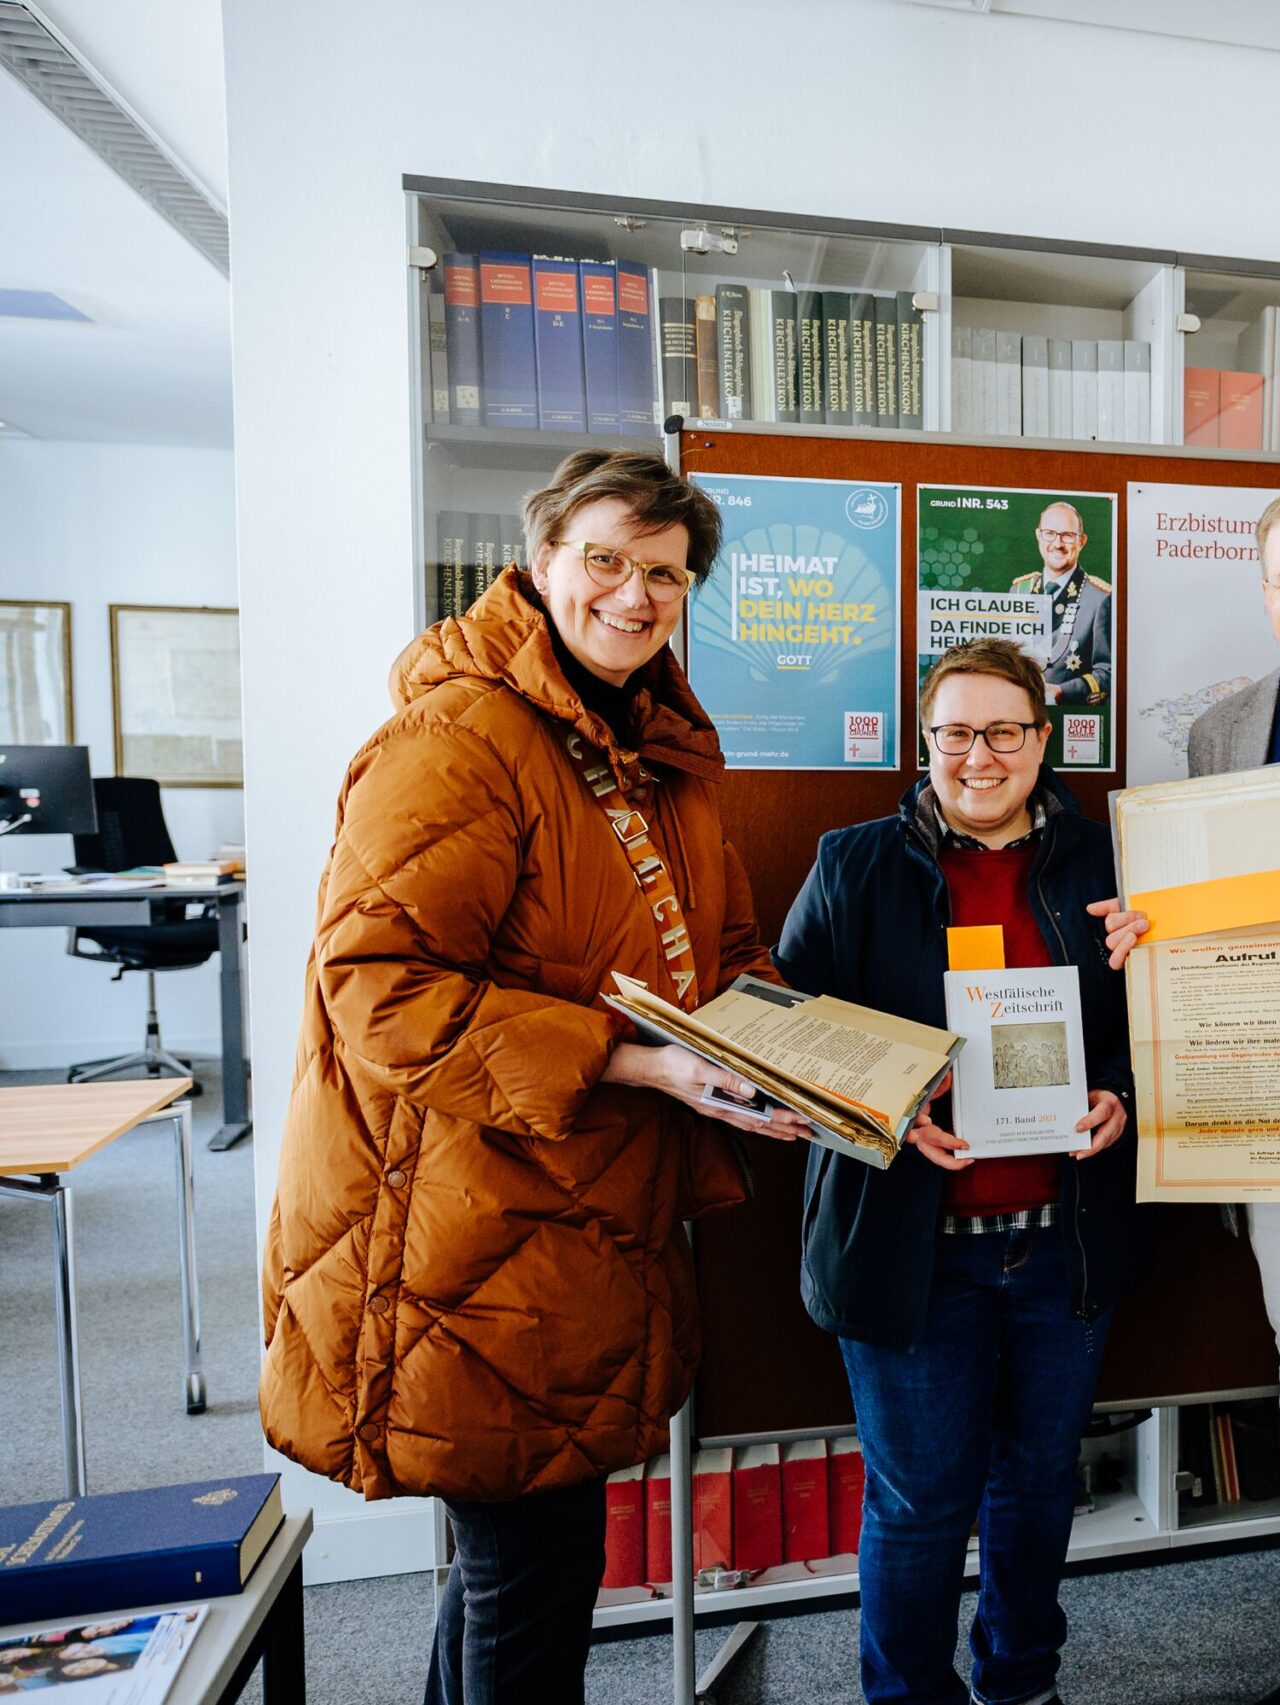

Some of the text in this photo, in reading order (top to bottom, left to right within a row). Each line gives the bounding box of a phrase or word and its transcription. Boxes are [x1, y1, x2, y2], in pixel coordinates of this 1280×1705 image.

[776, 318, 786, 412] KIRCHENLEXIKON
[802, 318, 812, 412] KIRCHENLEXIKON
[827, 319, 838, 412] KIRCHENLEXIKON
[852, 320, 864, 412] KIRCHENLEXIKON
[876, 324, 886, 416] KIRCHENLEXIKON
[900, 323, 911, 414] KIRCHENLEXIKON
[728, 496, 752, 507] 846
[930, 498, 1009, 510] GRUND NR. 543
[1156, 512, 1258, 534] Erzbistum
[1156, 539, 1261, 562] Paderborn
[474, 542, 484, 602] KIRCHENL
[740, 554, 838, 575] HEIMAT
[444, 538, 454, 617] KIRCHENLEXIK
[740, 576, 834, 599] IST, WO
[740, 600, 876, 622] DEIN HERZ
[930, 598, 1040, 614] ICH GLAUBE.
[740, 623, 862, 646] HINGEHT.
[930, 620, 1045, 636] DA FINDE ICH
[777, 654, 812, 666] GOTT
[849, 724, 878, 732] GUTE
[850, 716, 878, 726] 1000
[1068, 719, 1096, 728] 1000
[1068, 727, 1096, 735] GUTE
[1215, 951, 1277, 962] Aufruf
[966, 986, 1055, 1002] Westfälische
[990, 1000, 1064, 1018] Zeitschrift
[996, 1117, 1012, 1125] 171.
[1015, 1116, 1036, 1124] Band
[1185, 1120, 1209, 1128] Darum
